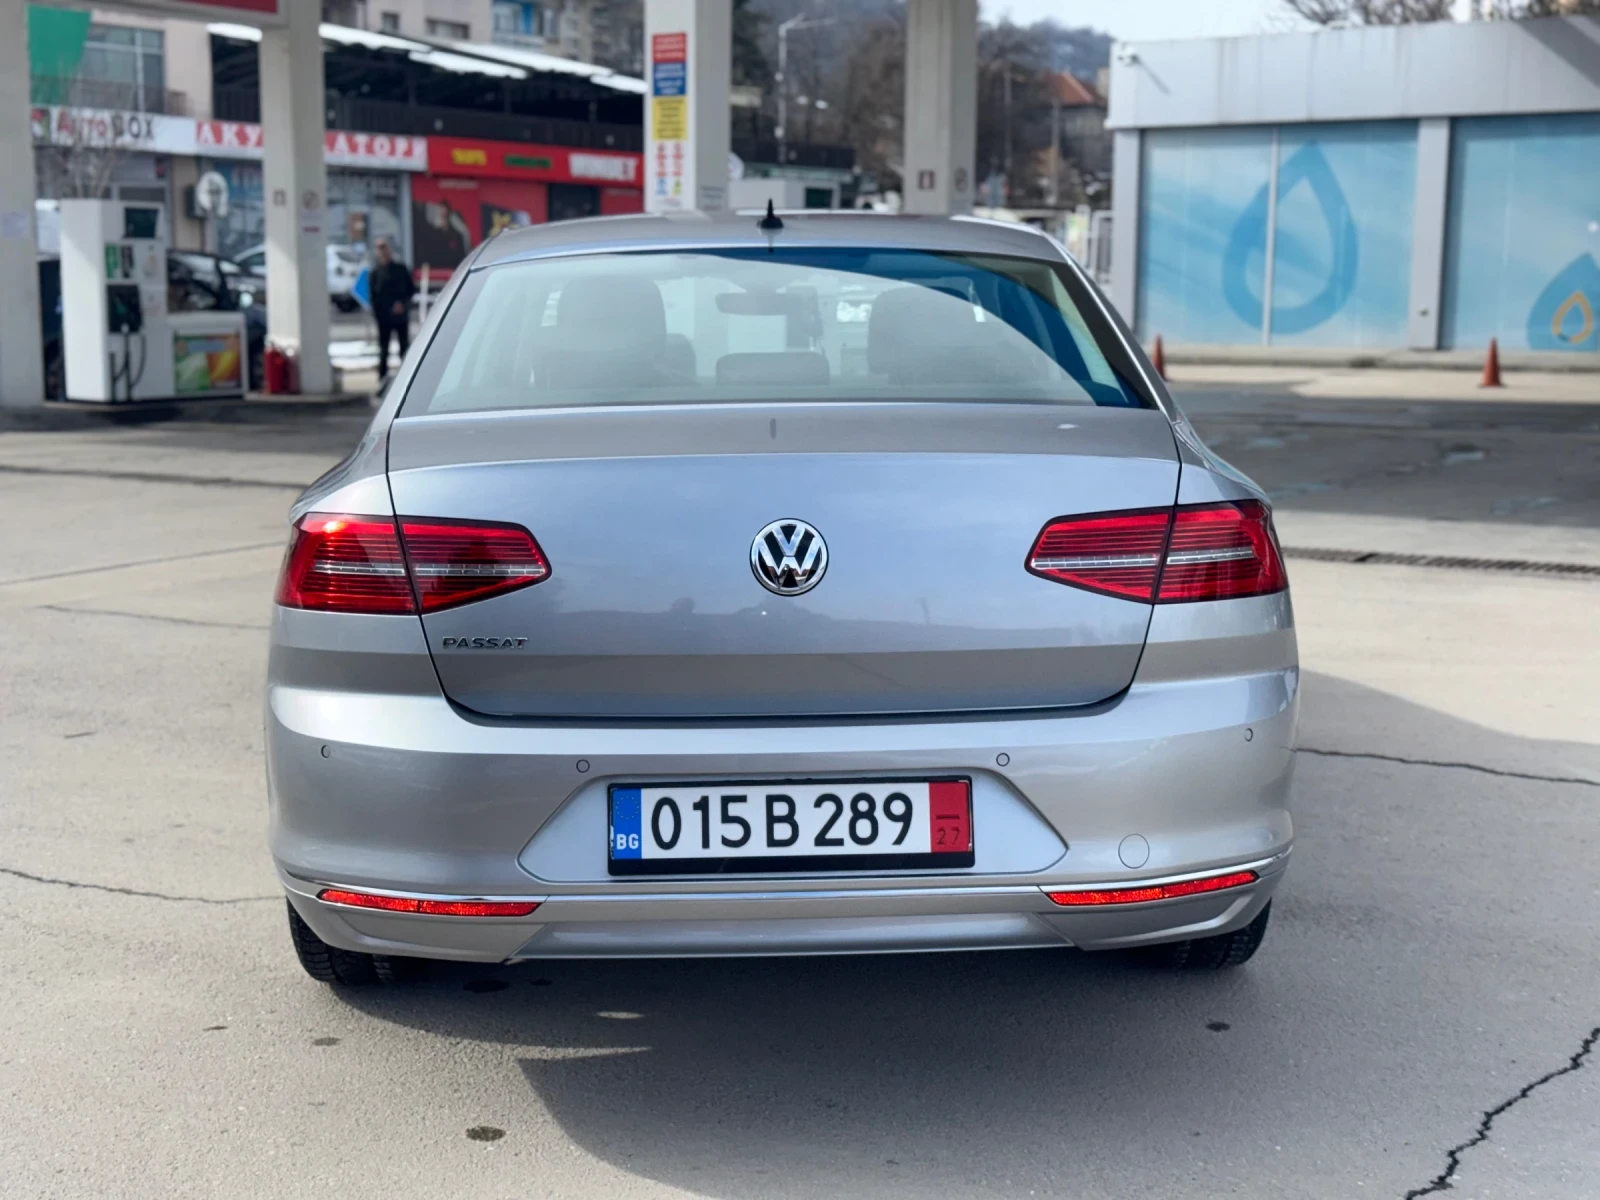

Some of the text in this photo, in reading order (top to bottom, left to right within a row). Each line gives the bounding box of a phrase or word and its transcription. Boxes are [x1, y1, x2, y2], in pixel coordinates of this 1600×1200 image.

[442, 636, 528, 649] PASSAT
[616, 833, 639, 850] BG
[936, 826, 961, 846] 27
